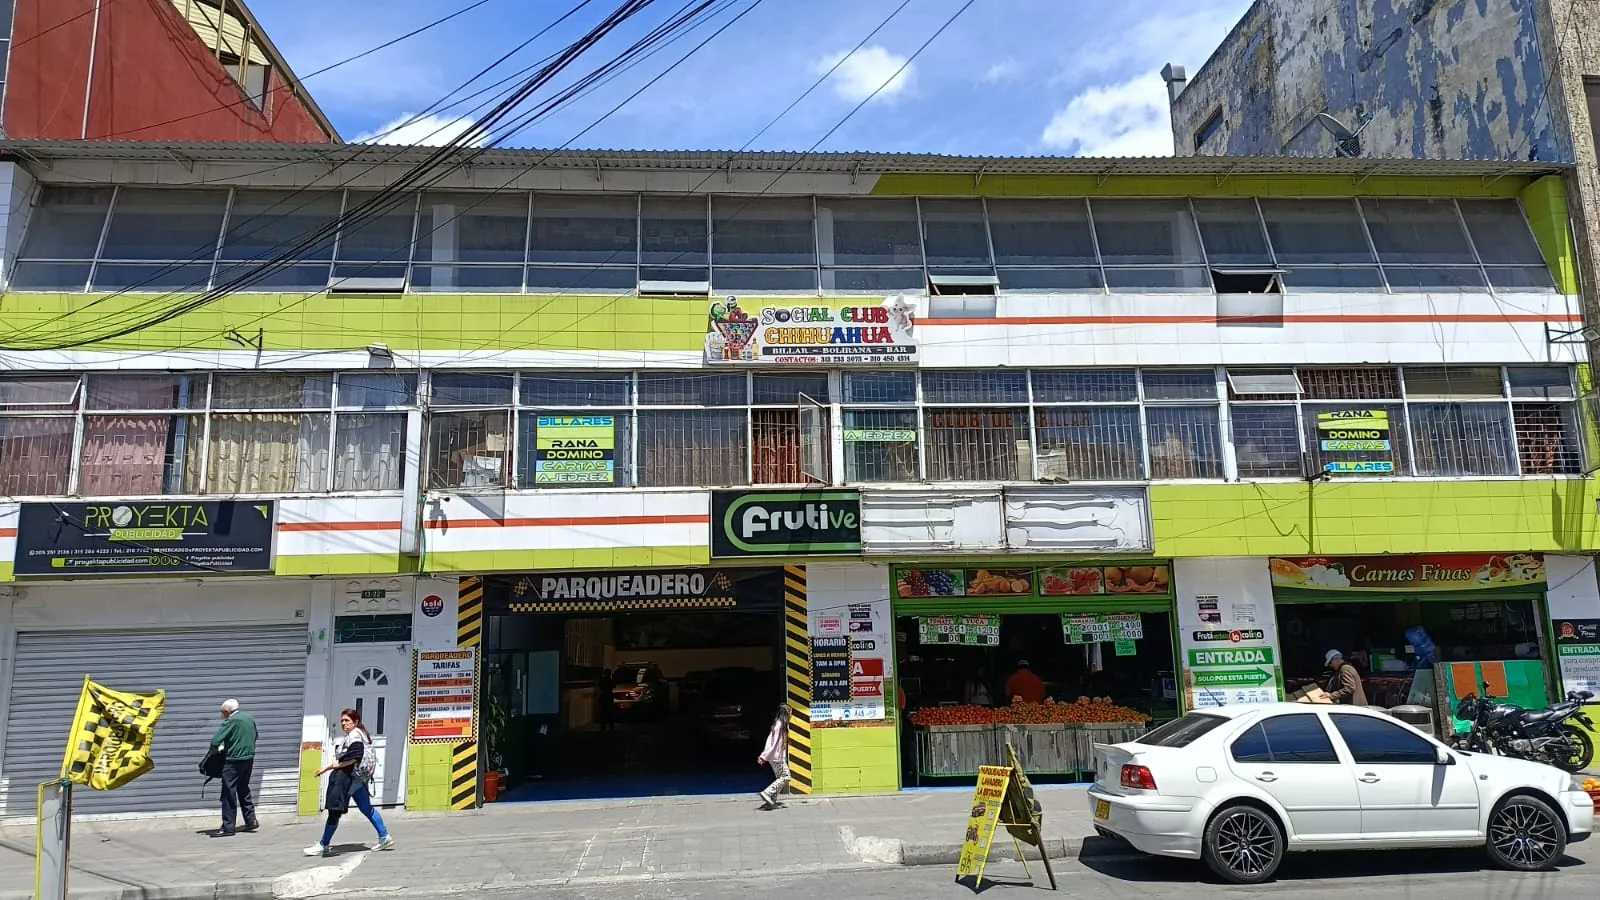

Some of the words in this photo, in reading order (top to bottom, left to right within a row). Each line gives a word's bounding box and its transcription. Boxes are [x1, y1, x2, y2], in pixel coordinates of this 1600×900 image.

[762, 306, 834, 325] SOCIAL
[841, 306, 889, 324] CLUB
[764, 326, 895, 344] CHIHUAHUA
[772, 347, 808, 355] BILLAR
[822, 346, 873, 354] BOLIRANA
[886, 345, 908, 353] BAR
[1331, 410, 1374, 418] RANA
[538, 416, 613, 425] BILLARES
[932, 411, 980, 428] CLUB
[1040, 410, 1091, 427] BILLAR
[1328, 430, 1381, 439] DOMINO
[551, 440, 599, 448] RANA
[1326, 440, 1385, 450] CARTAS
[547, 450, 604, 459] DOMINO
[542, 461, 607, 471] CARTAS
[1325, 462, 1392, 471] BILLARES
[537, 472, 609, 482] AJEDREZ
[114, 530, 176, 538] PUBLICIDAD
[1349, 564, 1415, 582] Carnes
[1419, 563, 1470, 581] Finas
[541, 573, 705, 600] PARQUEADERO
[813, 638, 847, 647] HORARIO
[421, 652, 472, 660] PARQUEADERO
[1195, 649, 1266, 664] ENTRADA
[432, 661, 461, 669] TARIFAS
